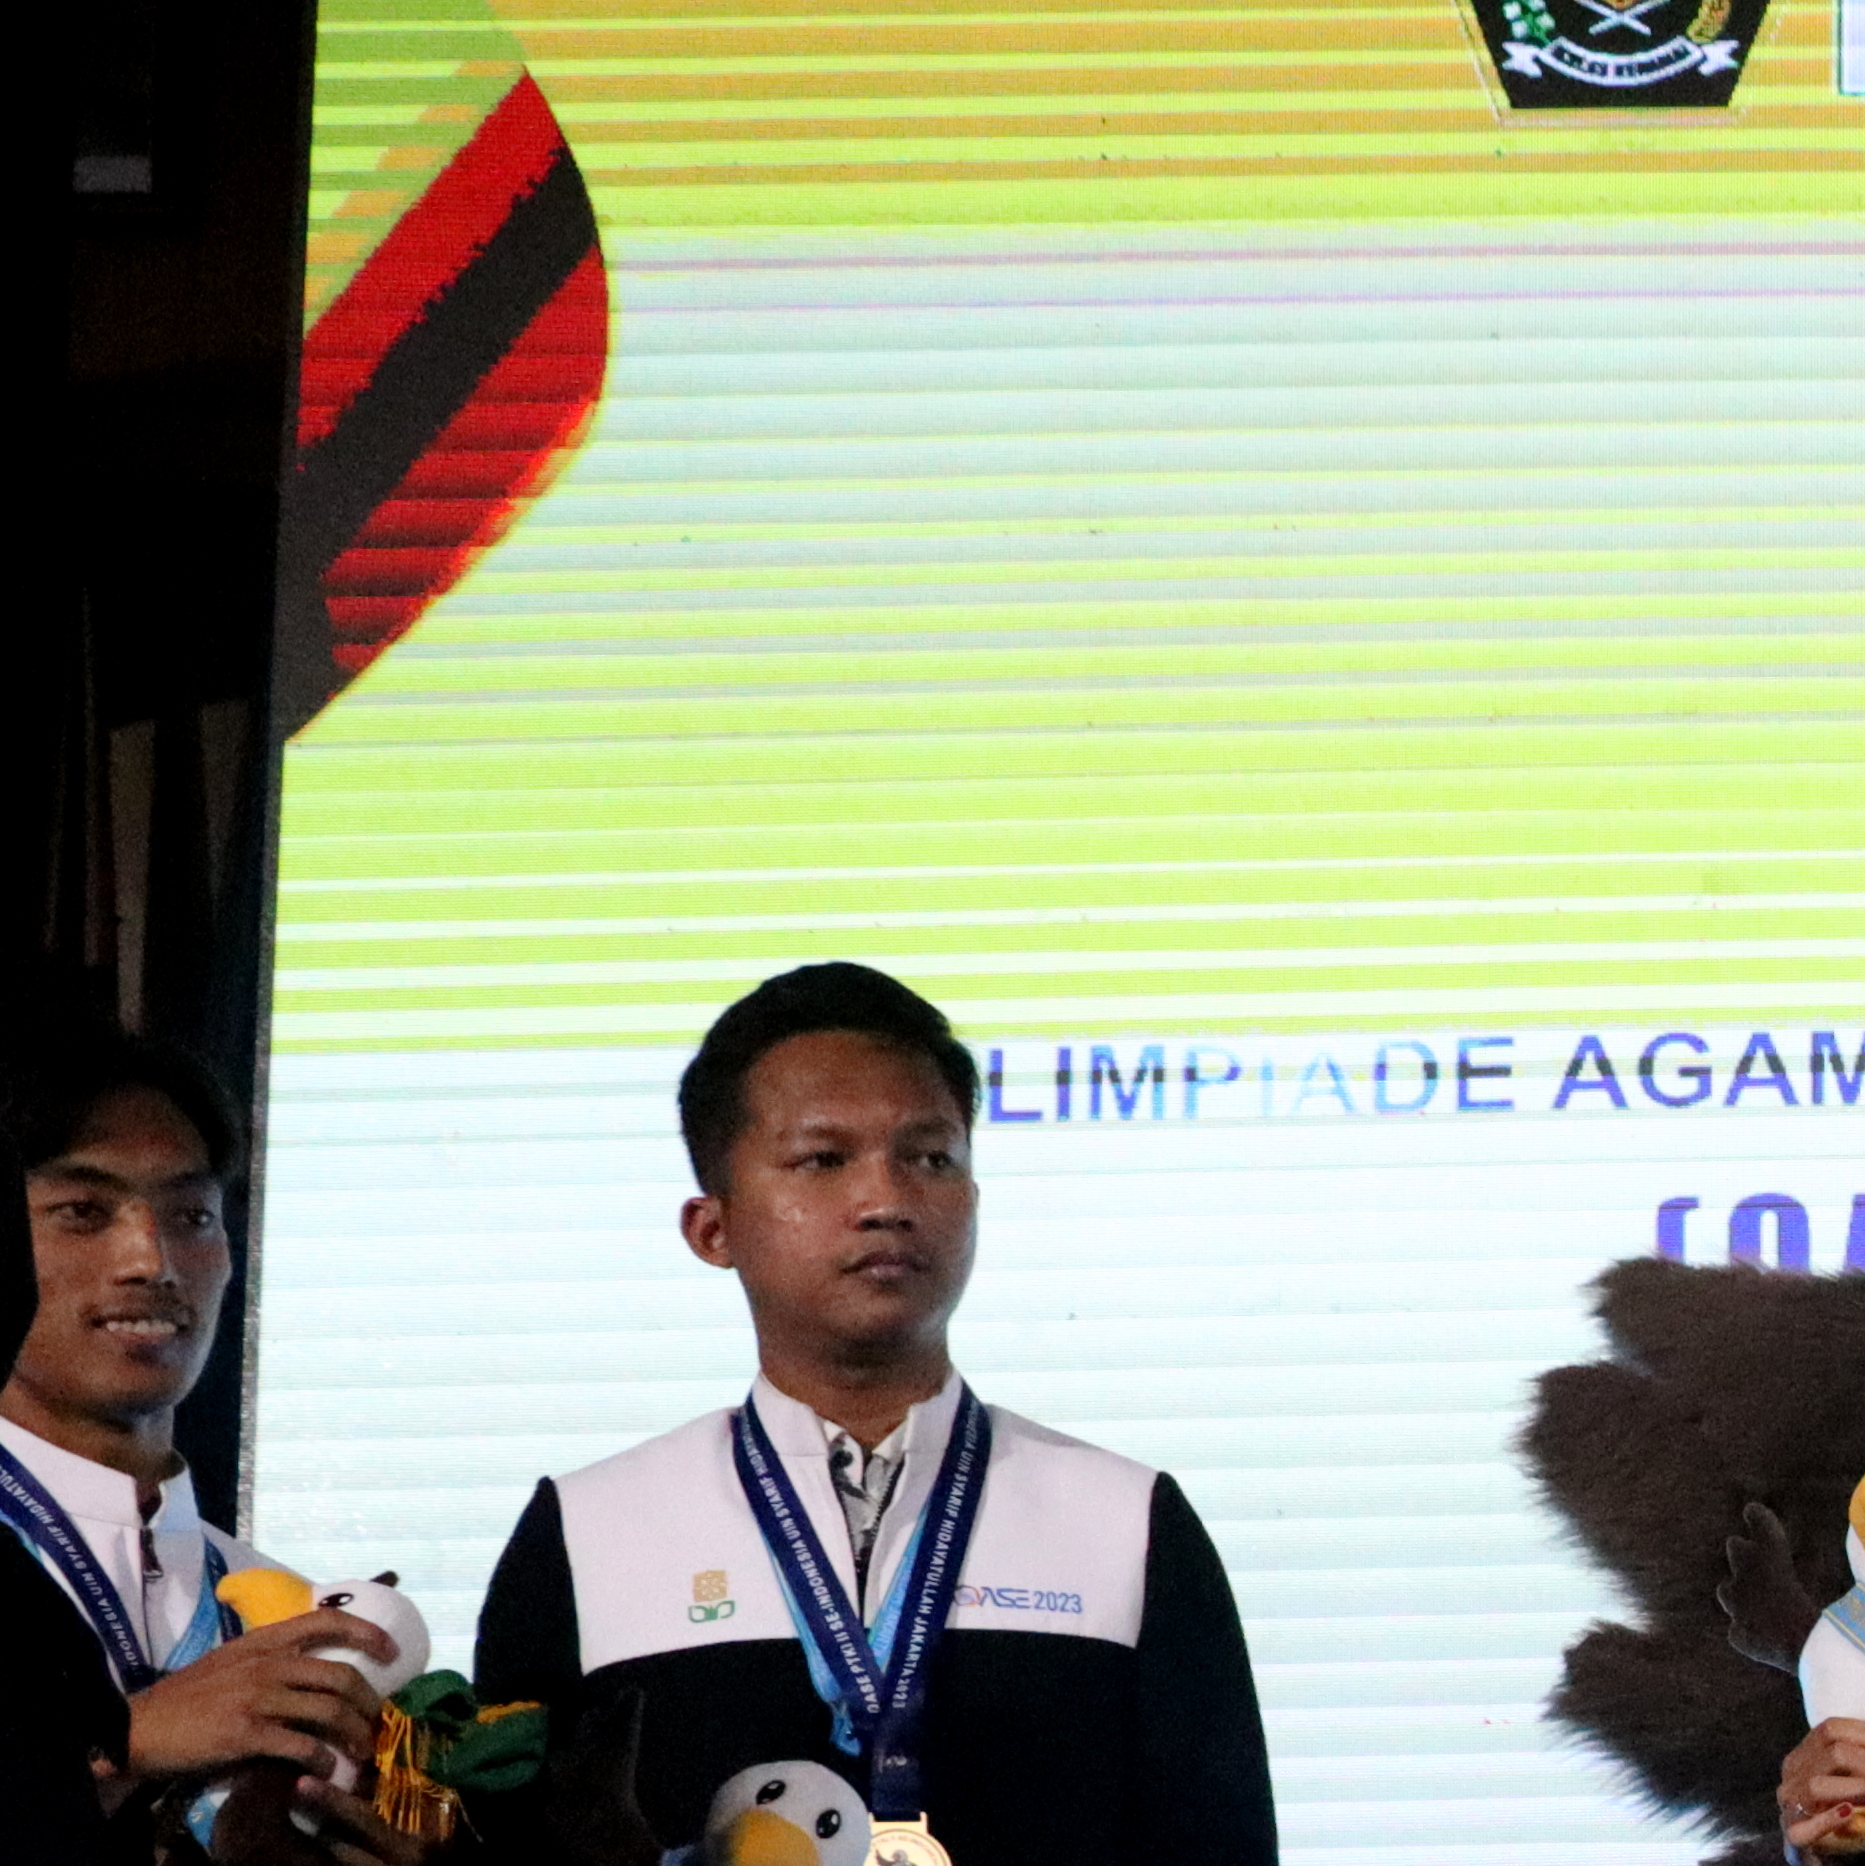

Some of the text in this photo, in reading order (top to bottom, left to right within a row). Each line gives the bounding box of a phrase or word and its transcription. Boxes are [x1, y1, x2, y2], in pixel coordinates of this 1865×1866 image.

[988, 1041, 1515, 1123] LIMPIADE
[956, 1450, 973, 1472] UIN
[760, 1474, 788, 1518] SYARIF
[780, 1516, 801, 1540] UIN
[82, 1571, 103, 1597] UIN
[915, 1518, 957, 1615] HIDAYATULLAH
[1033, 1591, 1082, 1614] 2023
[839, 1640, 866, 1676] PTKI
[897, 1615, 930, 1678] JAKARTA
[853, 1672, 883, 1715] OASE
